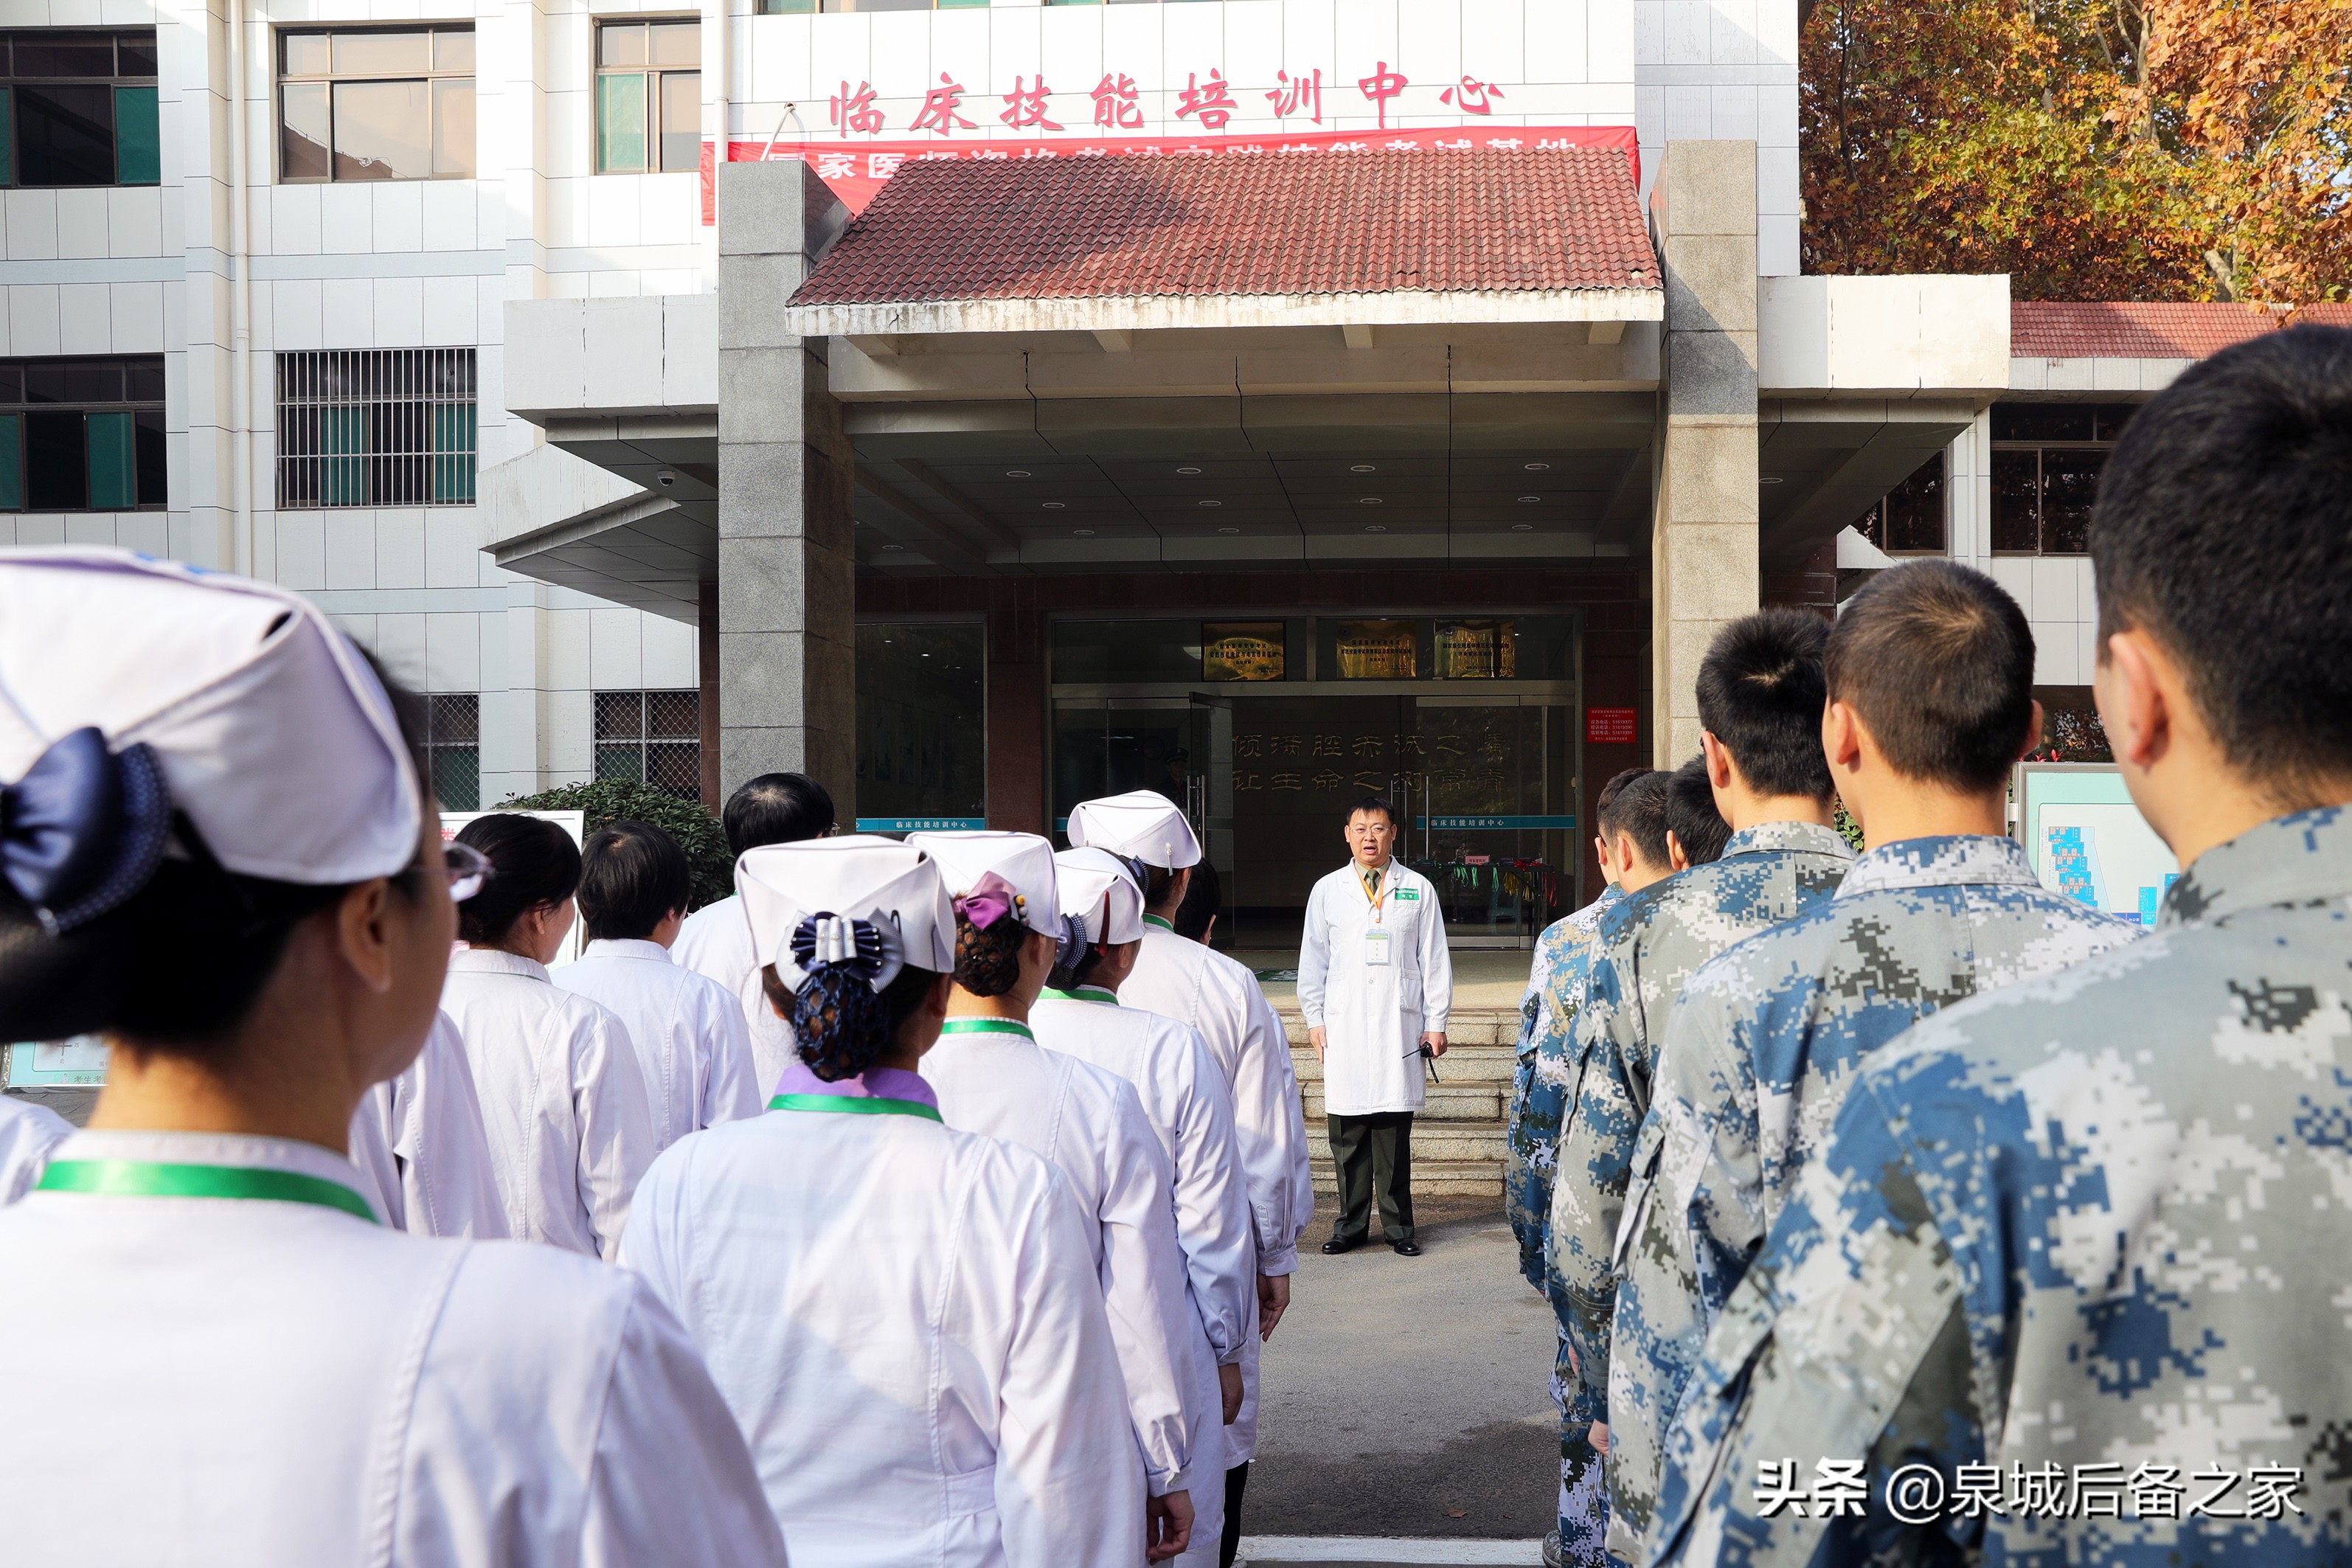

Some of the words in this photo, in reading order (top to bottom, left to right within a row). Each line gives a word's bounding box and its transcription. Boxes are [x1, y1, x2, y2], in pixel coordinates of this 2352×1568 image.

[829, 60, 1505, 139] 临床技能培训中心
[1431, 819, 1505, 827] 临床技能培训中心
